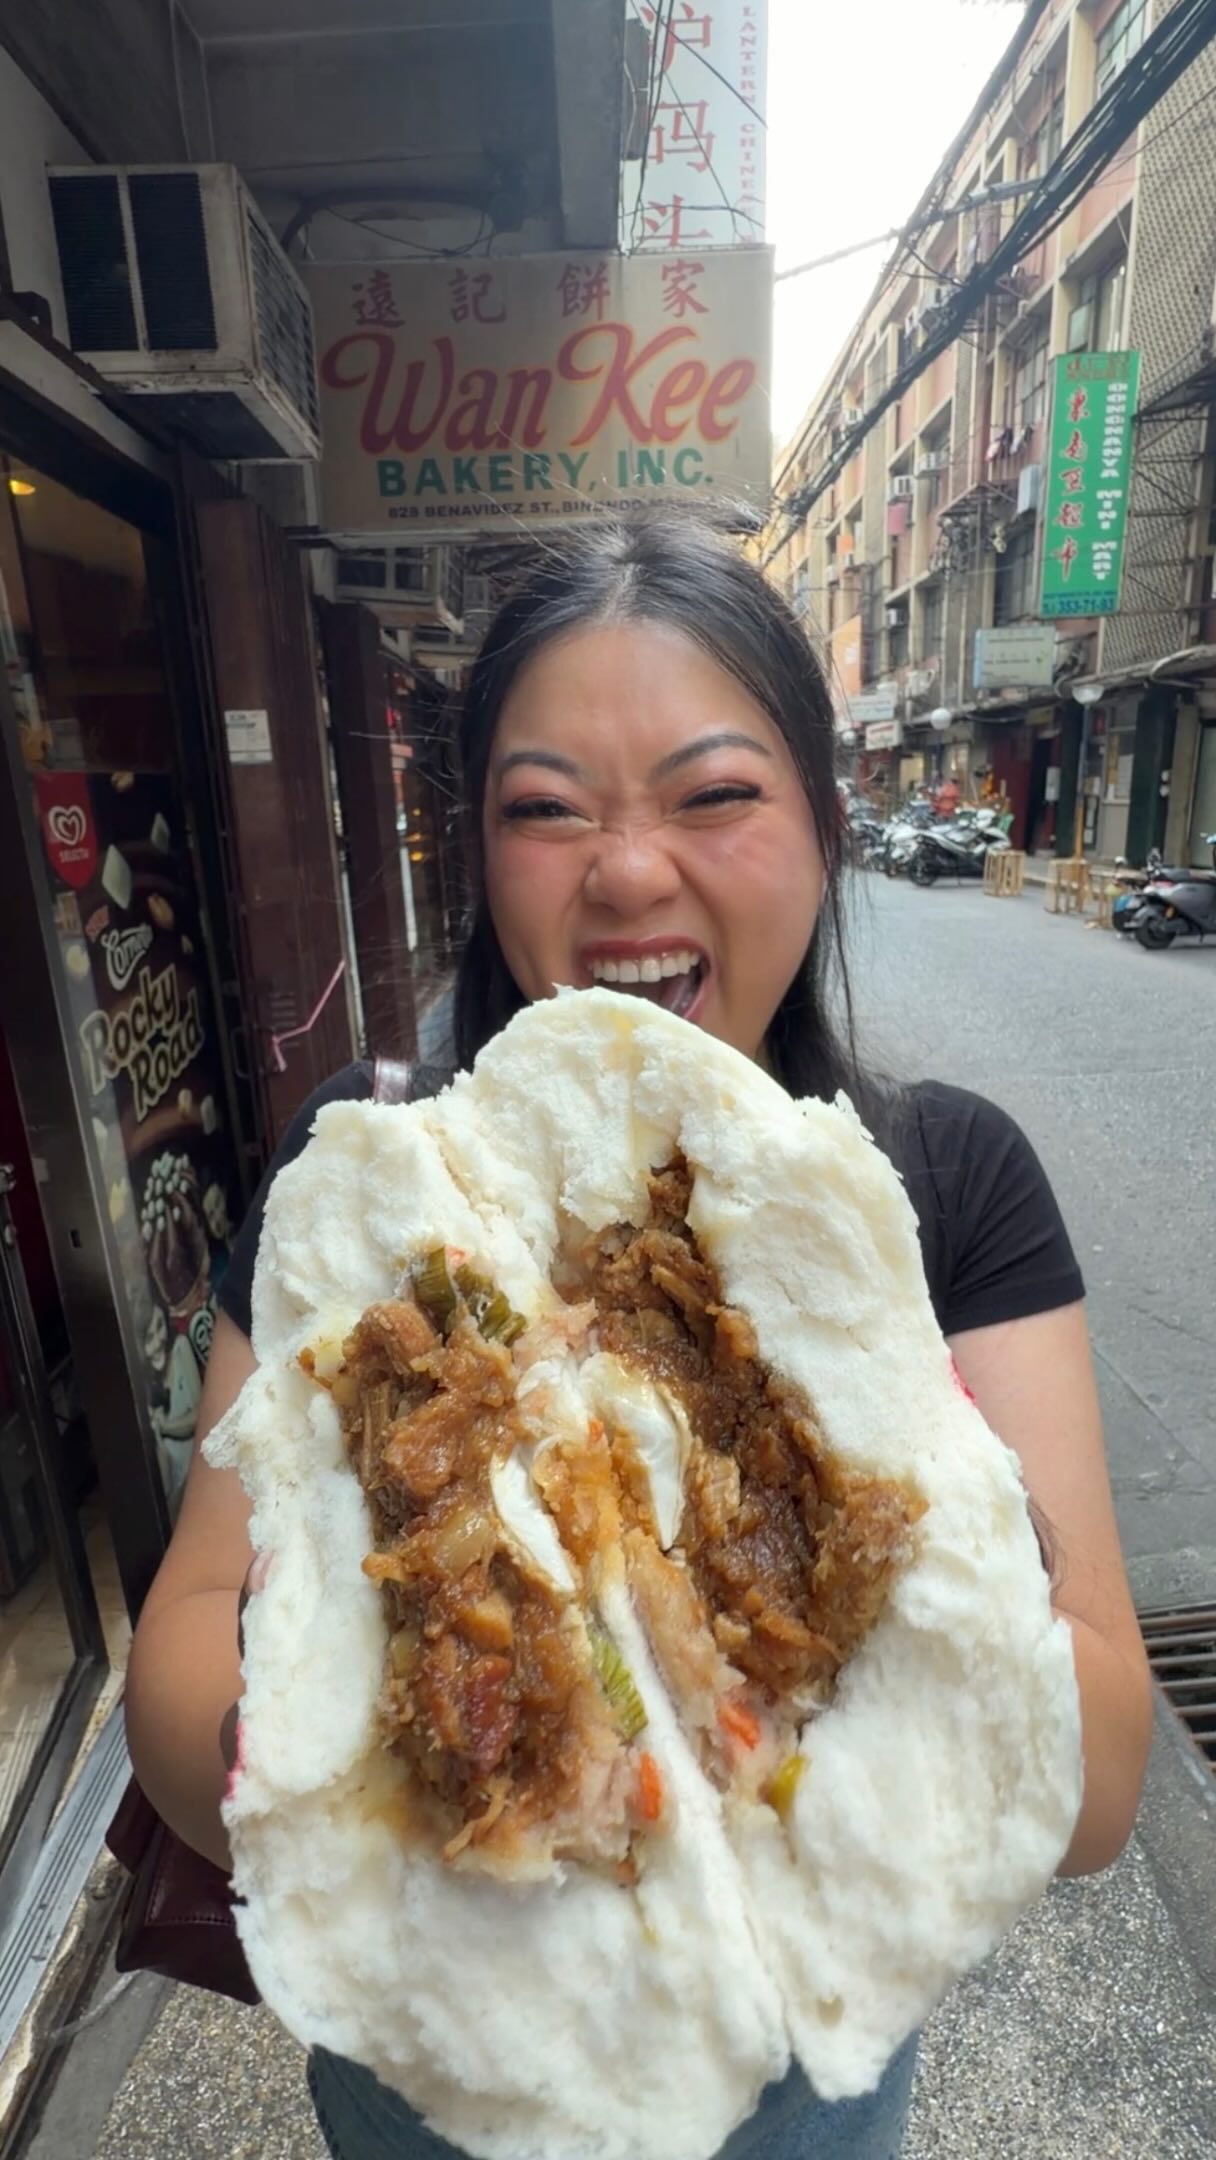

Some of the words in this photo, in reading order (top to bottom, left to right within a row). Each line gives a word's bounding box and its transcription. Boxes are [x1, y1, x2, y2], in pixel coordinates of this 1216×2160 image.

[740, 7, 757, 104] LANTERN
[351, 258, 709, 330] 遠記餅家
[320, 331, 553, 456] Wan
[556, 321, 756, 449] Kee
[376, 452, 598, 498] BAKERY,
[616, 447, 714, 488] INC.
[424, 502, 523, 518] BENAVIDEZ
[1096, 489, 1122, 530] MINI
[1092, 541, 1117, 580] MART
[80, 963, 180, 1094] Rocky
[129, 987, 205, 1123] Road
